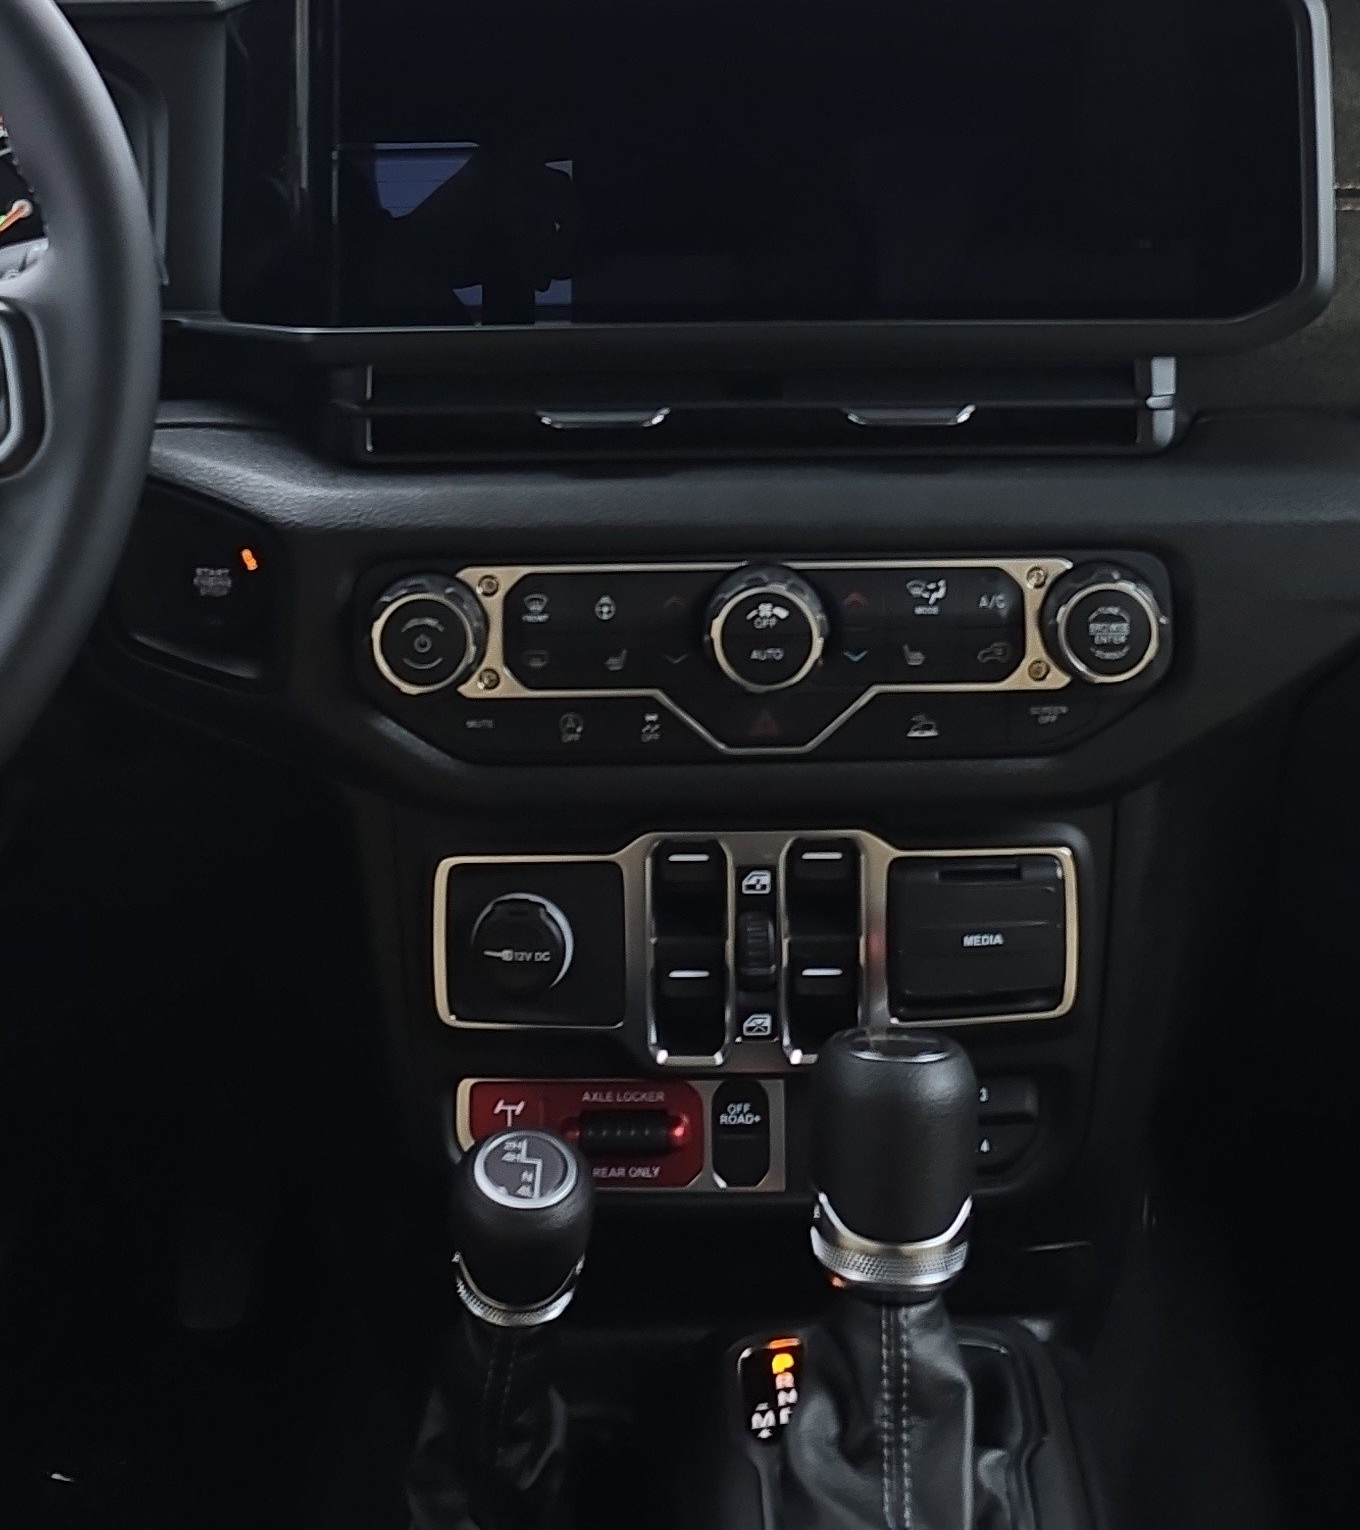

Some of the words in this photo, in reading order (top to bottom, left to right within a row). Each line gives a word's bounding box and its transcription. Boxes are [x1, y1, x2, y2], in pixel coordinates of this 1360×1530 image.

[978, 592, 1008, 609] A/C
[750, 647, 785, 661] AUTO
[962, 933, 1004, 948] MEDIA
[513, 949, 533, 962] 12V
[535, 950, 552, 962] DC
[582, 1092, 614, 1103] AXLE
[616, 1091, 665, 1103] LOCKER
[727, 1103, 751, 1113] OFF
[592, 1167, 626, 1178] REAR
[628, 1166, 661, 1178] ONLY
[771, 1353, 794, 1374] P
[751, 1410, 776, 1430] M
